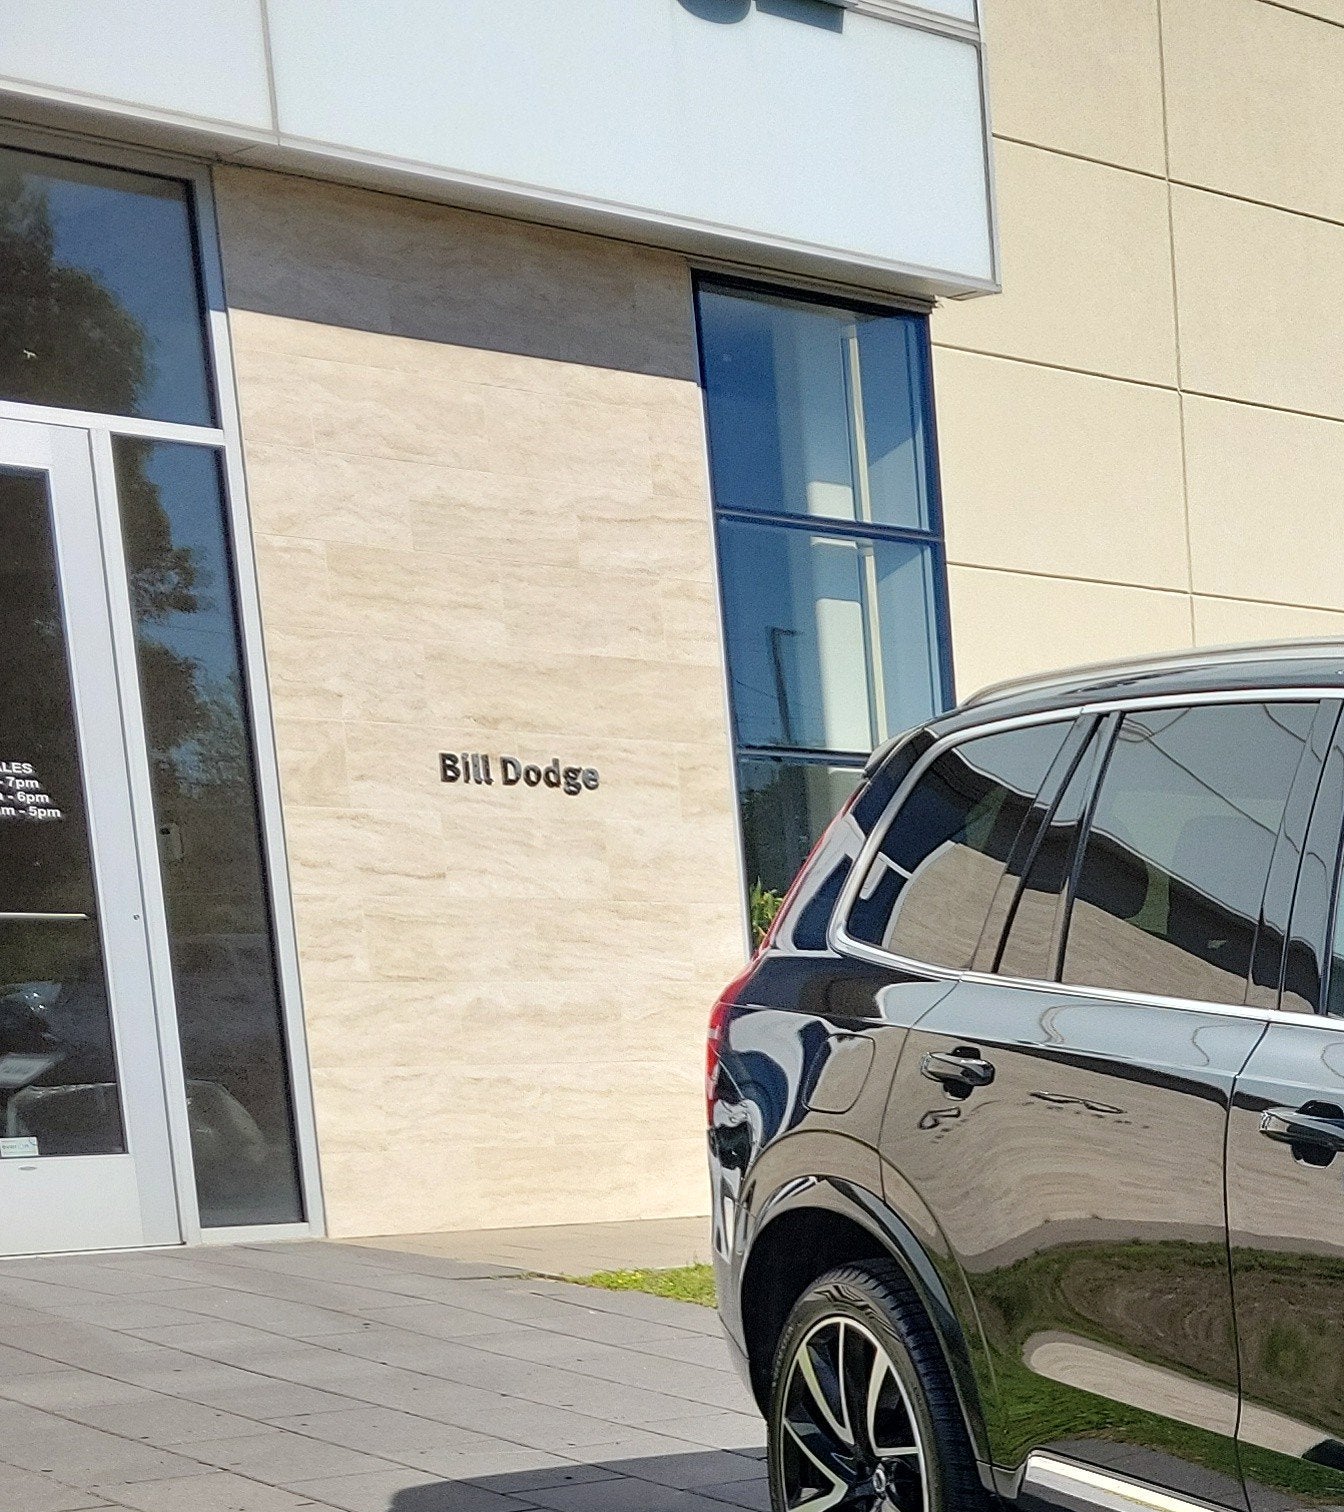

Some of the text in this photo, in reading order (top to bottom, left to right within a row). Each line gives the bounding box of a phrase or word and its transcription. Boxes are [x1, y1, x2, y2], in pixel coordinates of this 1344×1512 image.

[0, 762, 33, 774] LES
[439, 752, 600, 796] Bill Dodge
[6, 777, 40, 789] 7pm
[17, 792, 50, 804] 6pm
[29, 806, 61, 819] 5pm
